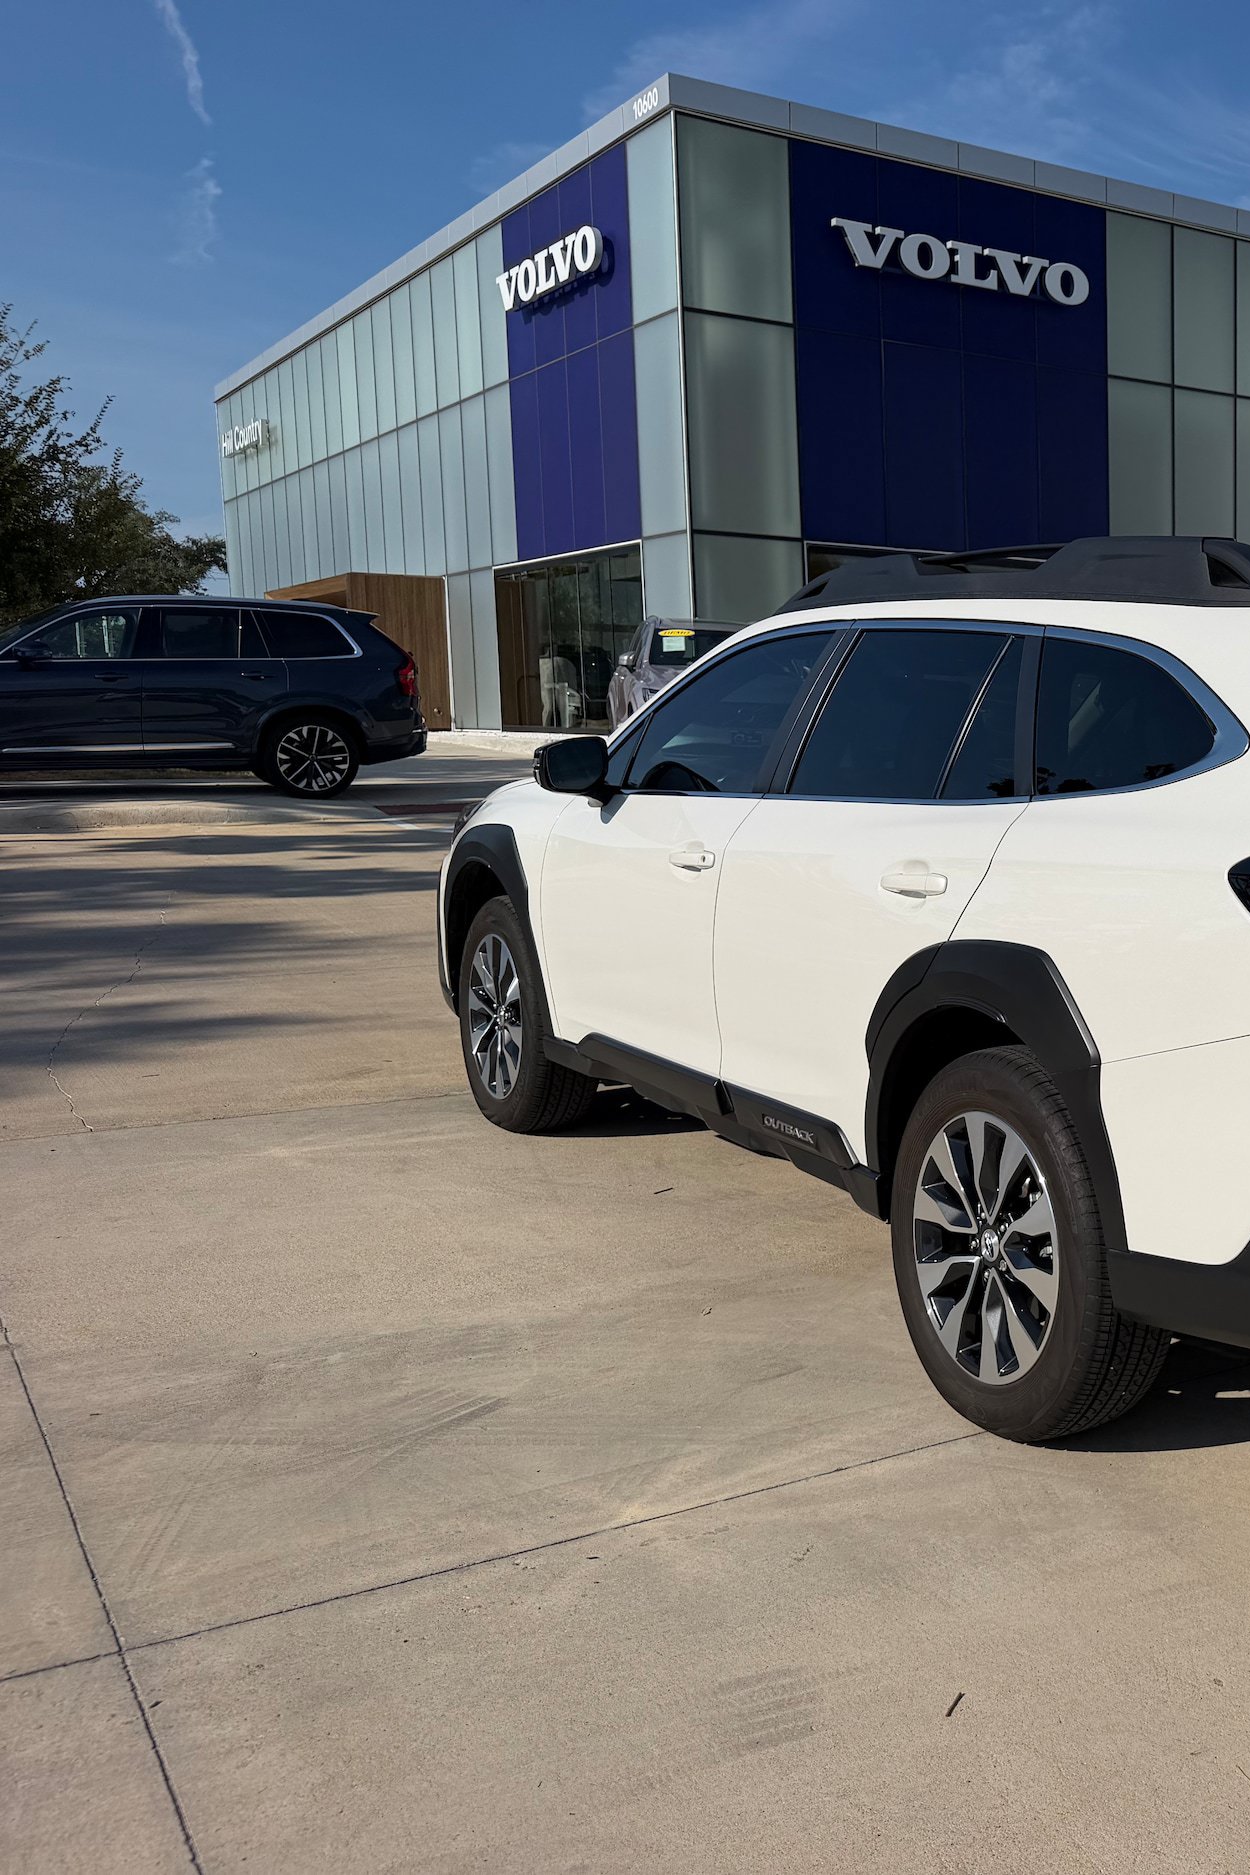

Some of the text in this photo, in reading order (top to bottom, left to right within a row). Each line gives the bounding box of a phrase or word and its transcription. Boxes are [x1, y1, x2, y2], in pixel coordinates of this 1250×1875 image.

[633, 87, 658, 120] 10600
[496, 225, 602, 311] VOLVO
[831, 217, 1089, 306] VOLVO
[222, 418, 262, 458] Hill Country
[763, 1115, 814, 1144] OUTBACK
